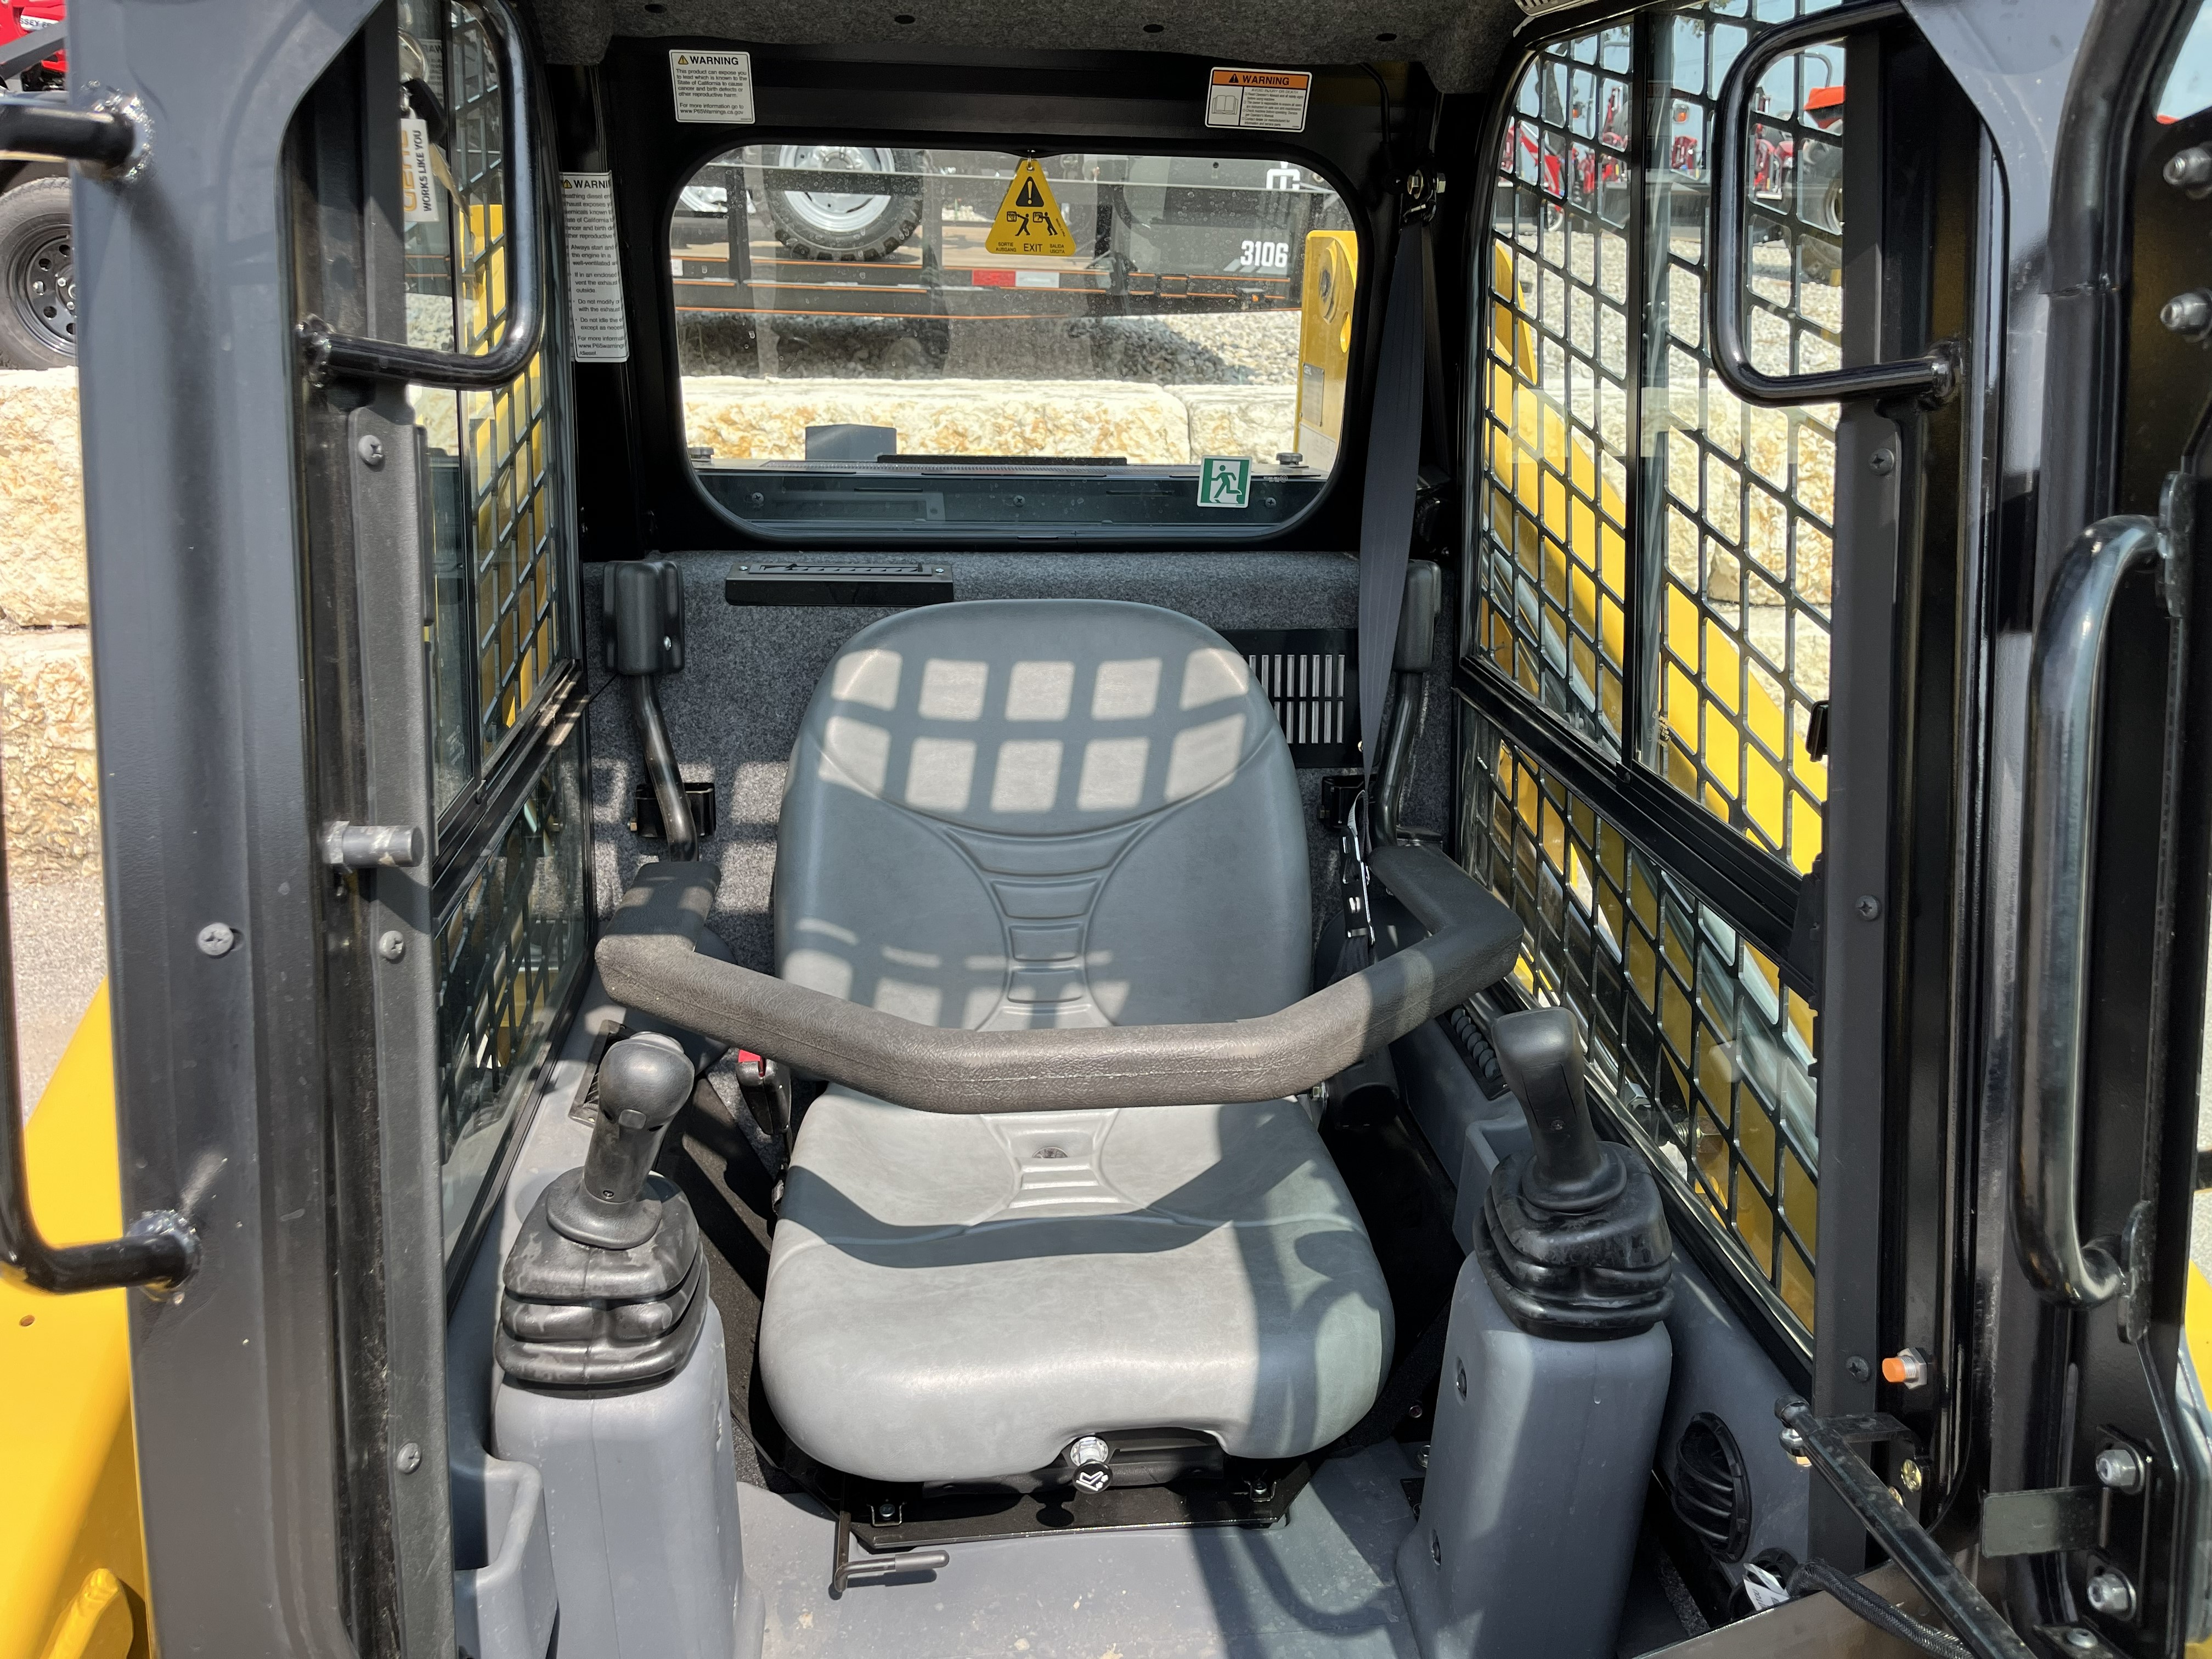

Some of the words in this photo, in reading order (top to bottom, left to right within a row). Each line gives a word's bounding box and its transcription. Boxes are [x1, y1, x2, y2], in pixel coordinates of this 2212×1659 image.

[690, 56, 738, 65] WARNING
[1243, 75, 1289, 86] WARNING
[413, 130, 422, 149] YOU
[416, 152, 426, 173] LIKE
[573, 179, 611, 189] WARNI
[419, 176, 431, 212] WORKS
[1024, 244, 1042, 252] EXIT
[1240, 240, 1289, 268] 3106
